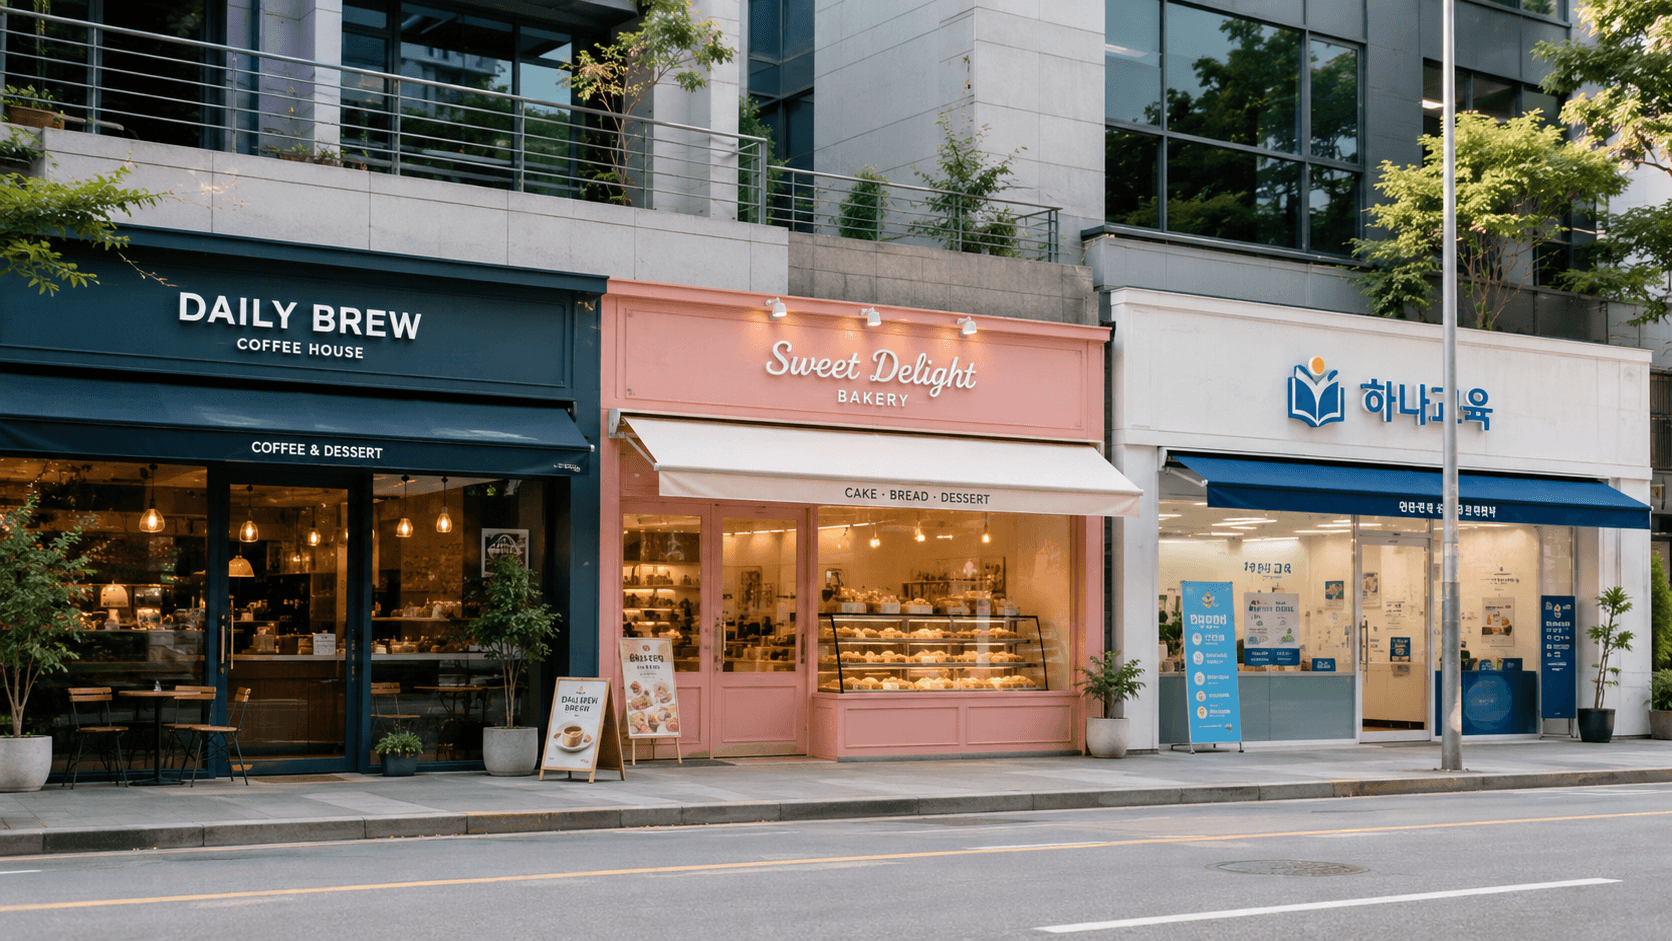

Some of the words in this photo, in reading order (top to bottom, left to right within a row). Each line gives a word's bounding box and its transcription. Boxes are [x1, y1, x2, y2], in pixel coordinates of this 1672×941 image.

[179, 291, 298, 329] DAILY
[312, 303, 422, 340] BREW
[236, 337, 302, 354] COFFEE
[308, 342, 364, 359] HOUSE
[765, 340, 861, 380] Sweet
[869, 349, 977, 398] Delight
[837, 389, 909, 407] BAKERY
[1360, 378, 1494, 431] 하나교육
[251, 441, 306, 456] COFFEE
[309, 444, 320, 456] &
[324, 444, 384, 460] DESSERT
[844, 487, 877, 500] CAKE
[890, 489, 929, 502] BREAD
[941, 491, 991, 505] DESSERT
